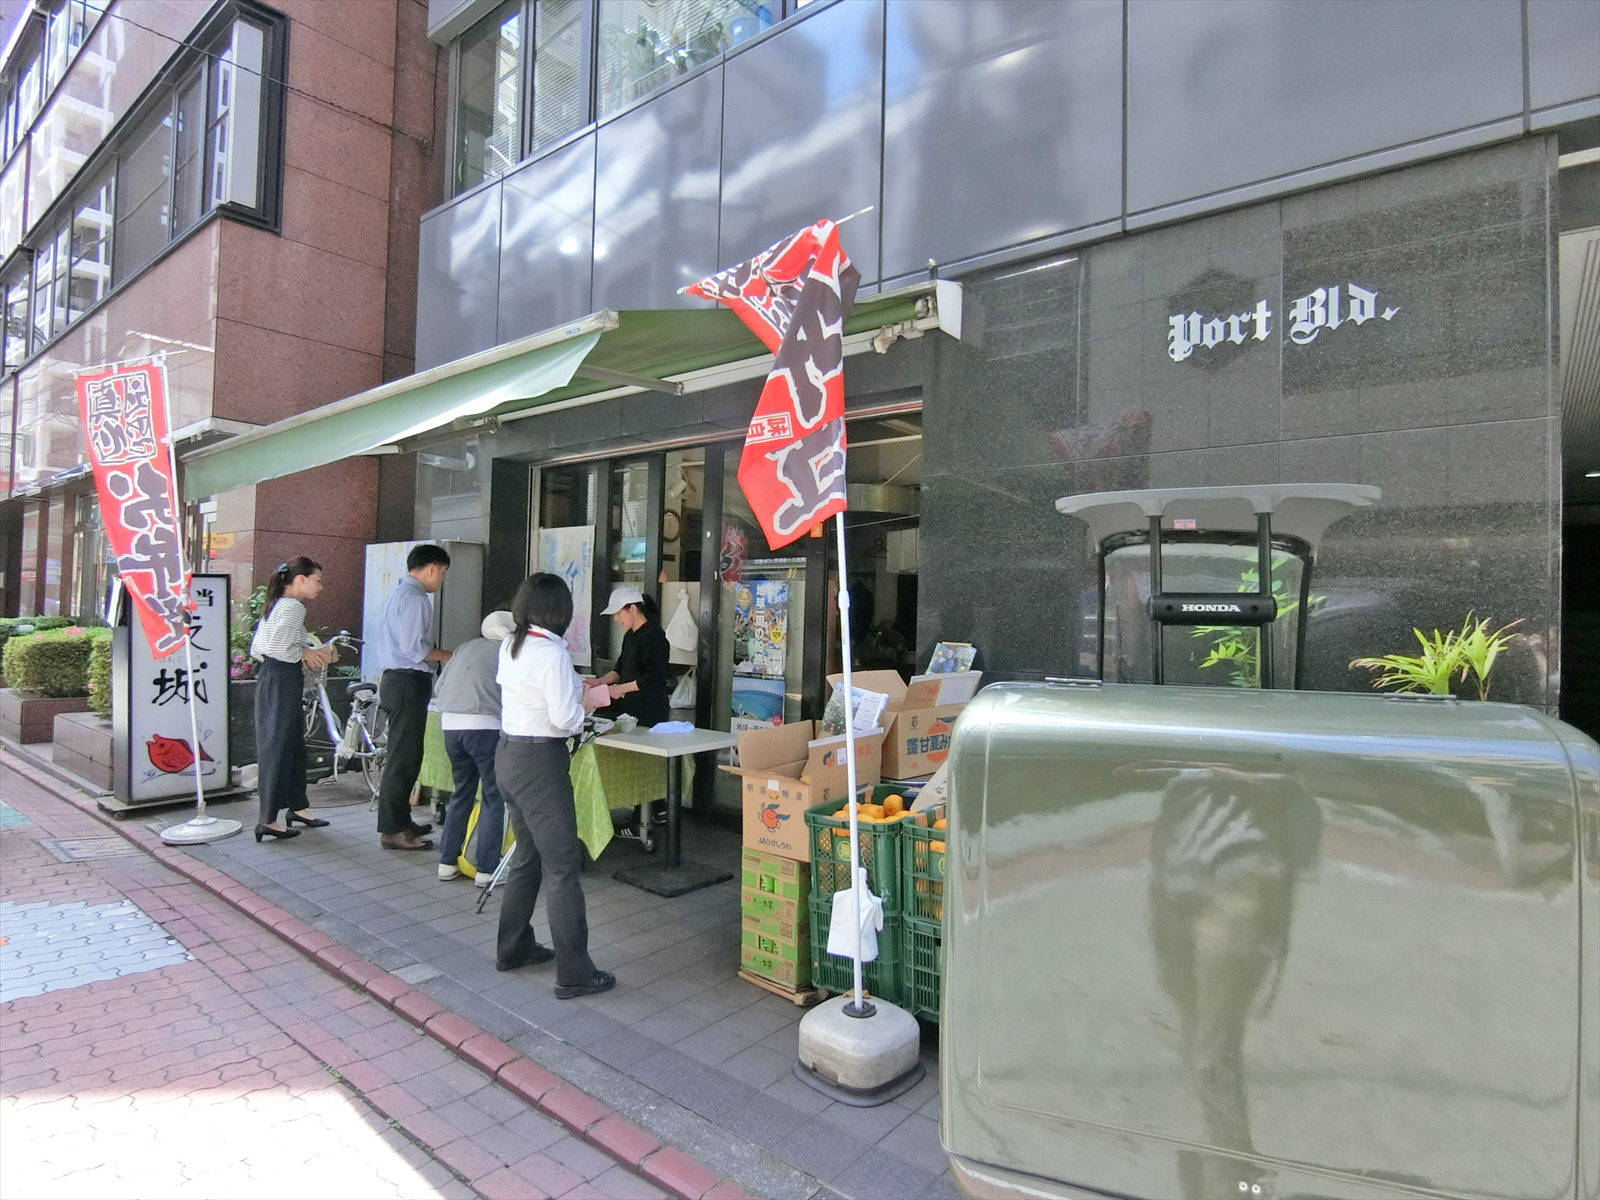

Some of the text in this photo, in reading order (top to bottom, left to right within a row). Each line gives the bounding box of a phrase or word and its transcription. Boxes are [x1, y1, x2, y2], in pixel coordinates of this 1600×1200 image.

[1167, 283, 1400, 362] Port Bld.
[1182, 604, 1241, 612] HONDA
